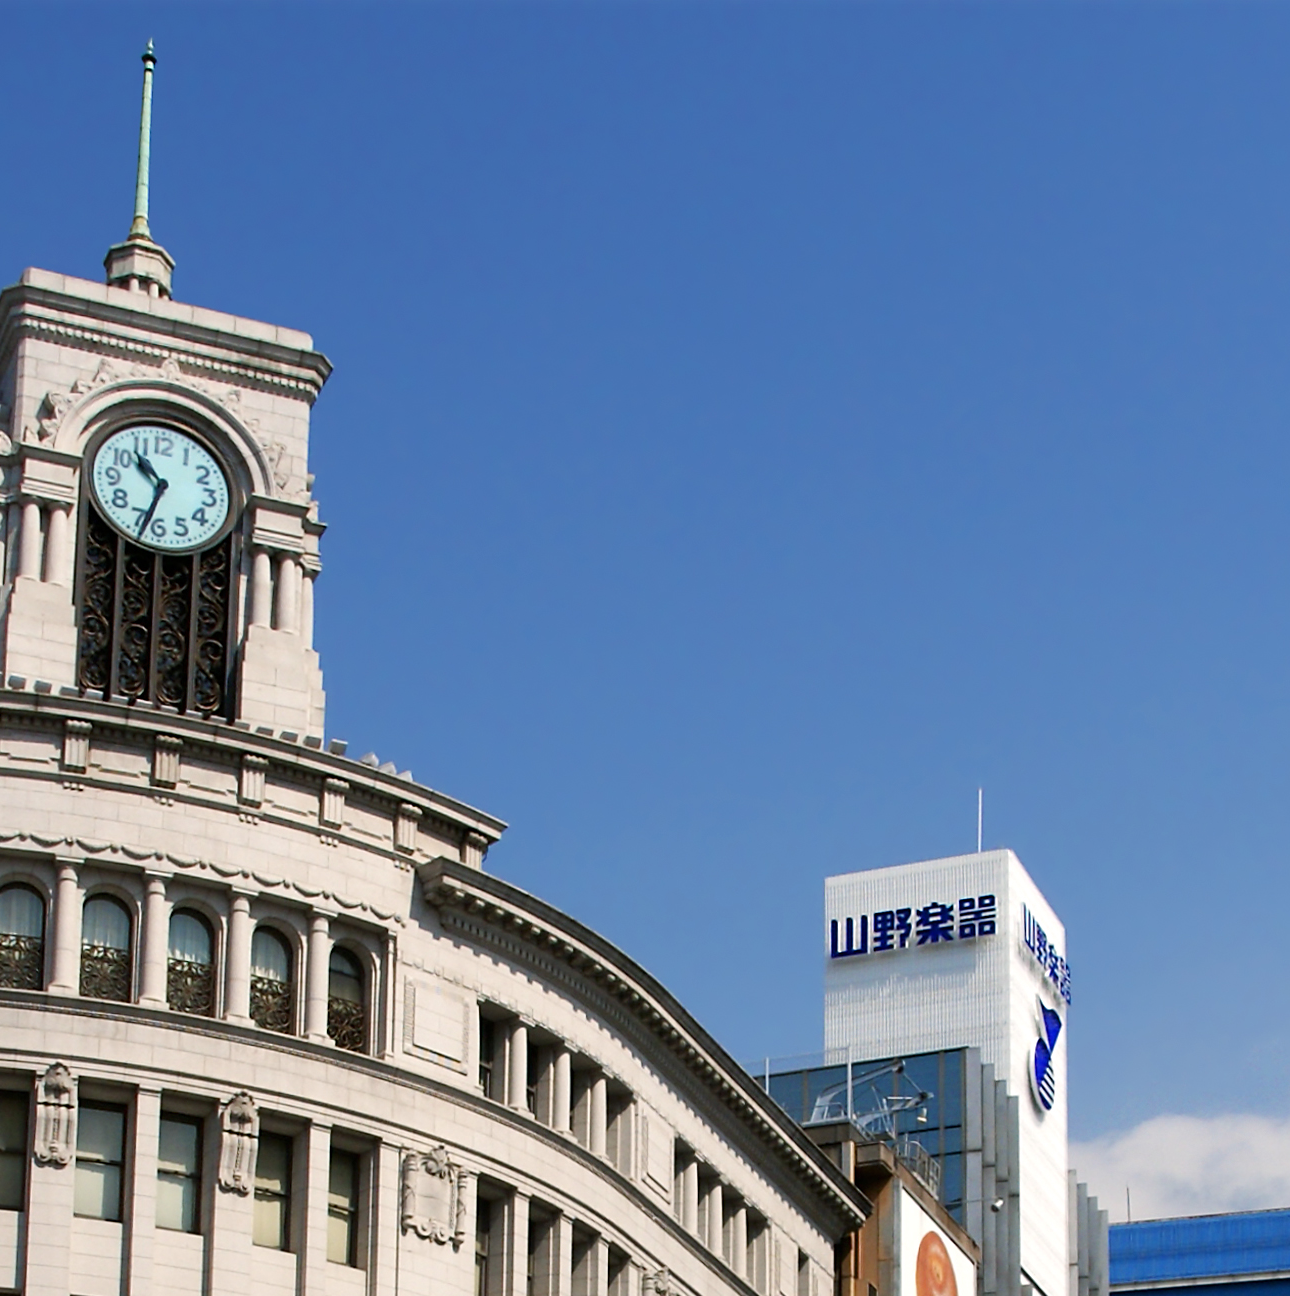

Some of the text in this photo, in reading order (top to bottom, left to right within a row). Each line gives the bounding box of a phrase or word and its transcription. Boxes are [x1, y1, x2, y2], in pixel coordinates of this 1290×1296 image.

[134, 436, 149, 456] 11
[154, 436, 174, 457] 12
[113, 447, 132, 468] 10
[182, 448, 190, 466] 1
[105, 467, 121, 485] 9
[196, 465, 210, 485] 2
[112, 488, 128, 508] 8
[202, 487, 217, 507] 3
[132, 507, 149, 527] 7
[173, 517, 189, 537] 5
[191, 508, 208, 526] 4
[150, 519, 167, 537] 6
[830, 894, 996, 959] 山野楽器
